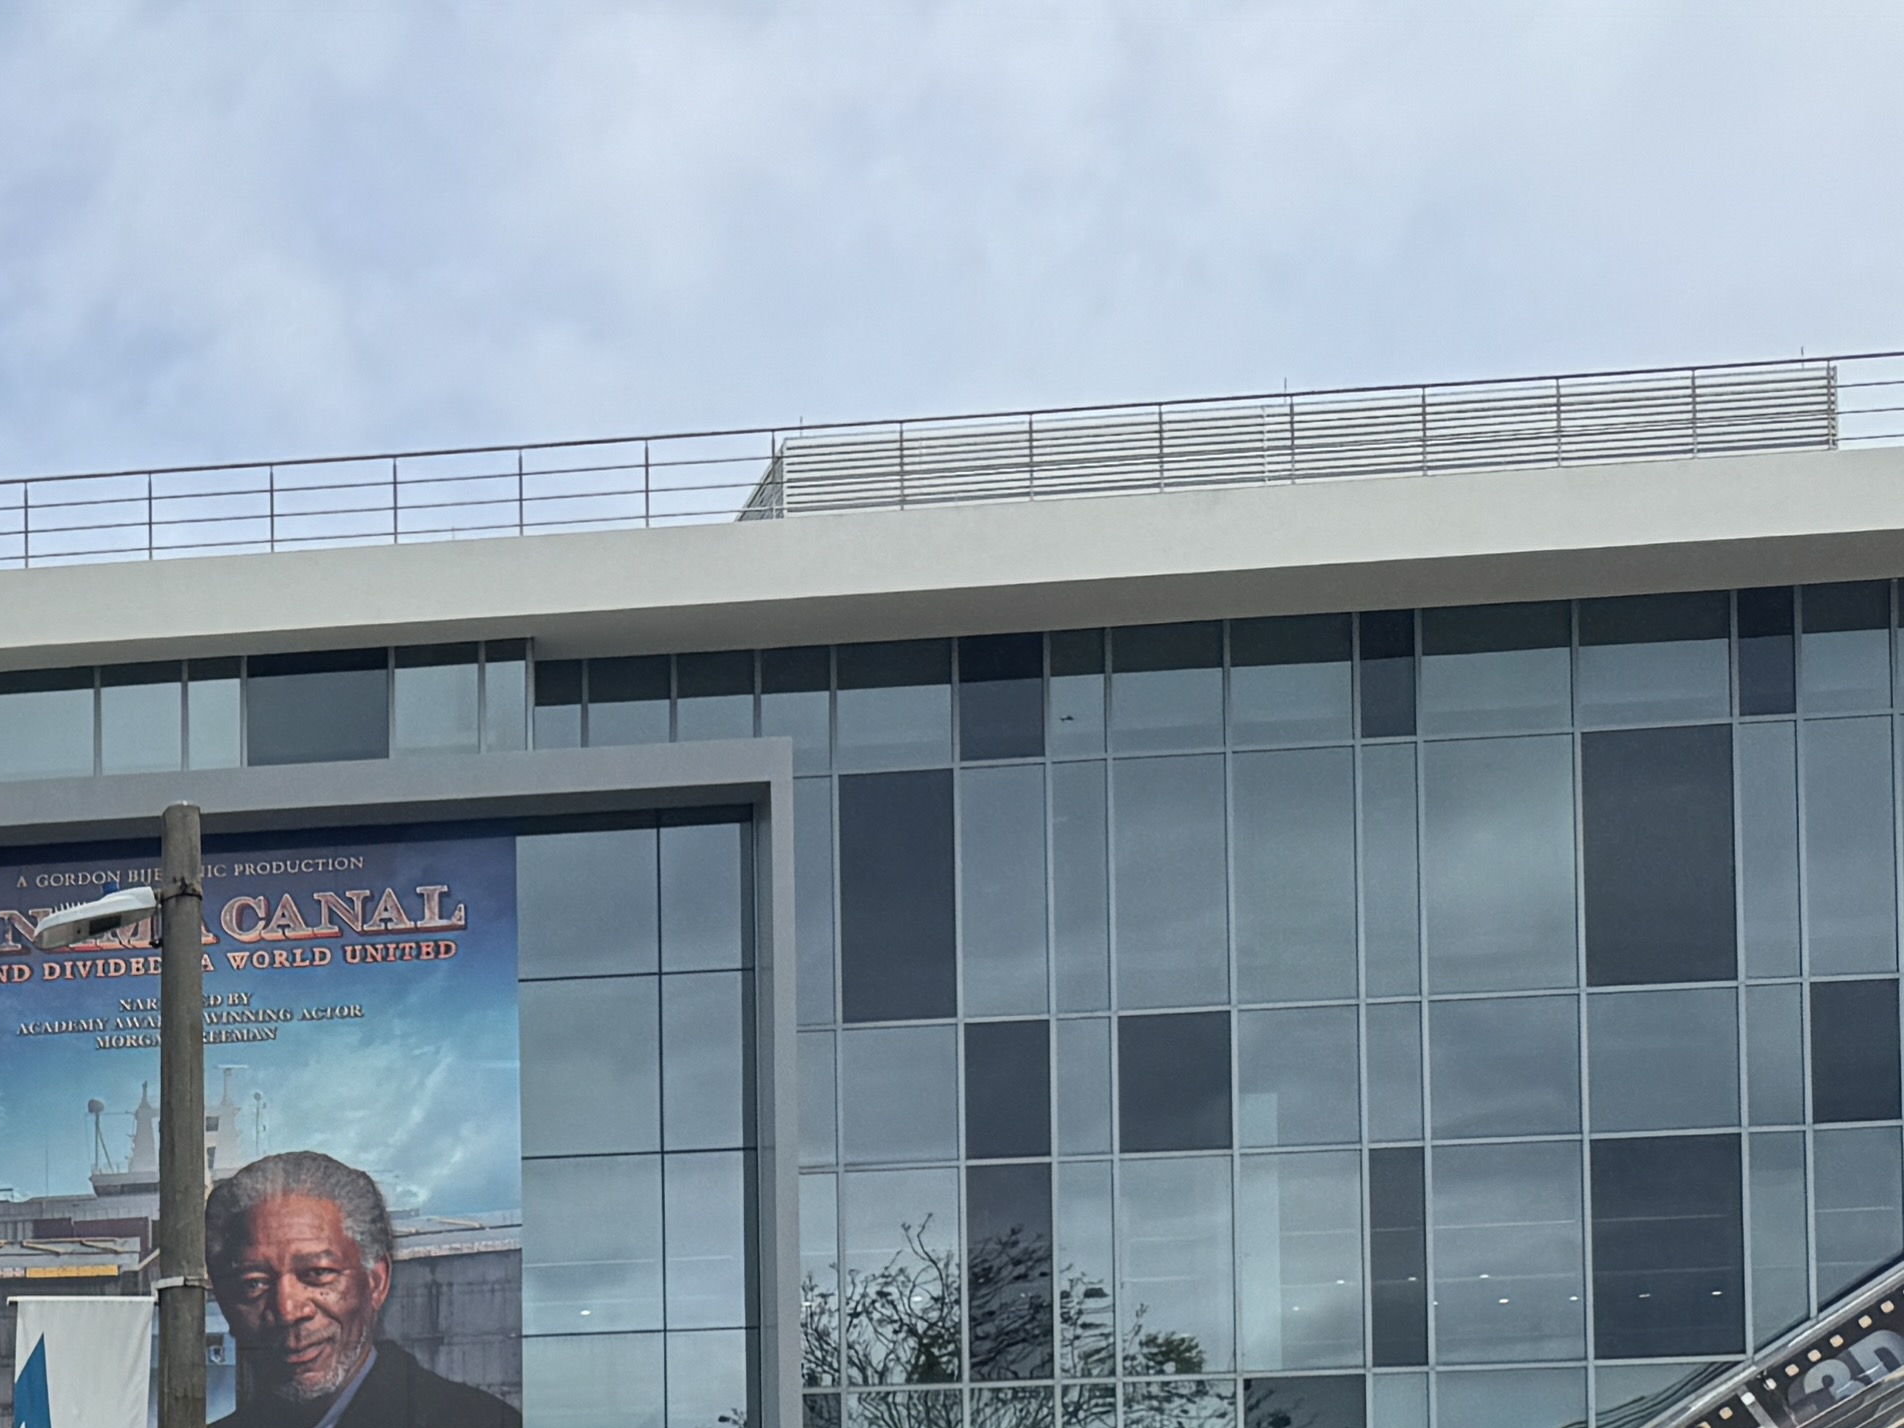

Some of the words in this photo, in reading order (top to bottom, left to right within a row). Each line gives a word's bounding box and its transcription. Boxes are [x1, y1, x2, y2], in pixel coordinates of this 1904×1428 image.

[16, 875, 28, 888] A
[36, 870, 121, 888] GORDON
[234, 856, 364, 876] PRODUCTION
[220, 884, 467, 943] CANAL
[201, 953, 214, 971] A
[226, 947, 332, 970] WORLD
[344, 940, 457, 964] UNITED
[228, 992, 253, 1006] BY
[16, 1018, 109, 1036] ACADEMY
[299, 1004, 364, 1021] ACTOR
